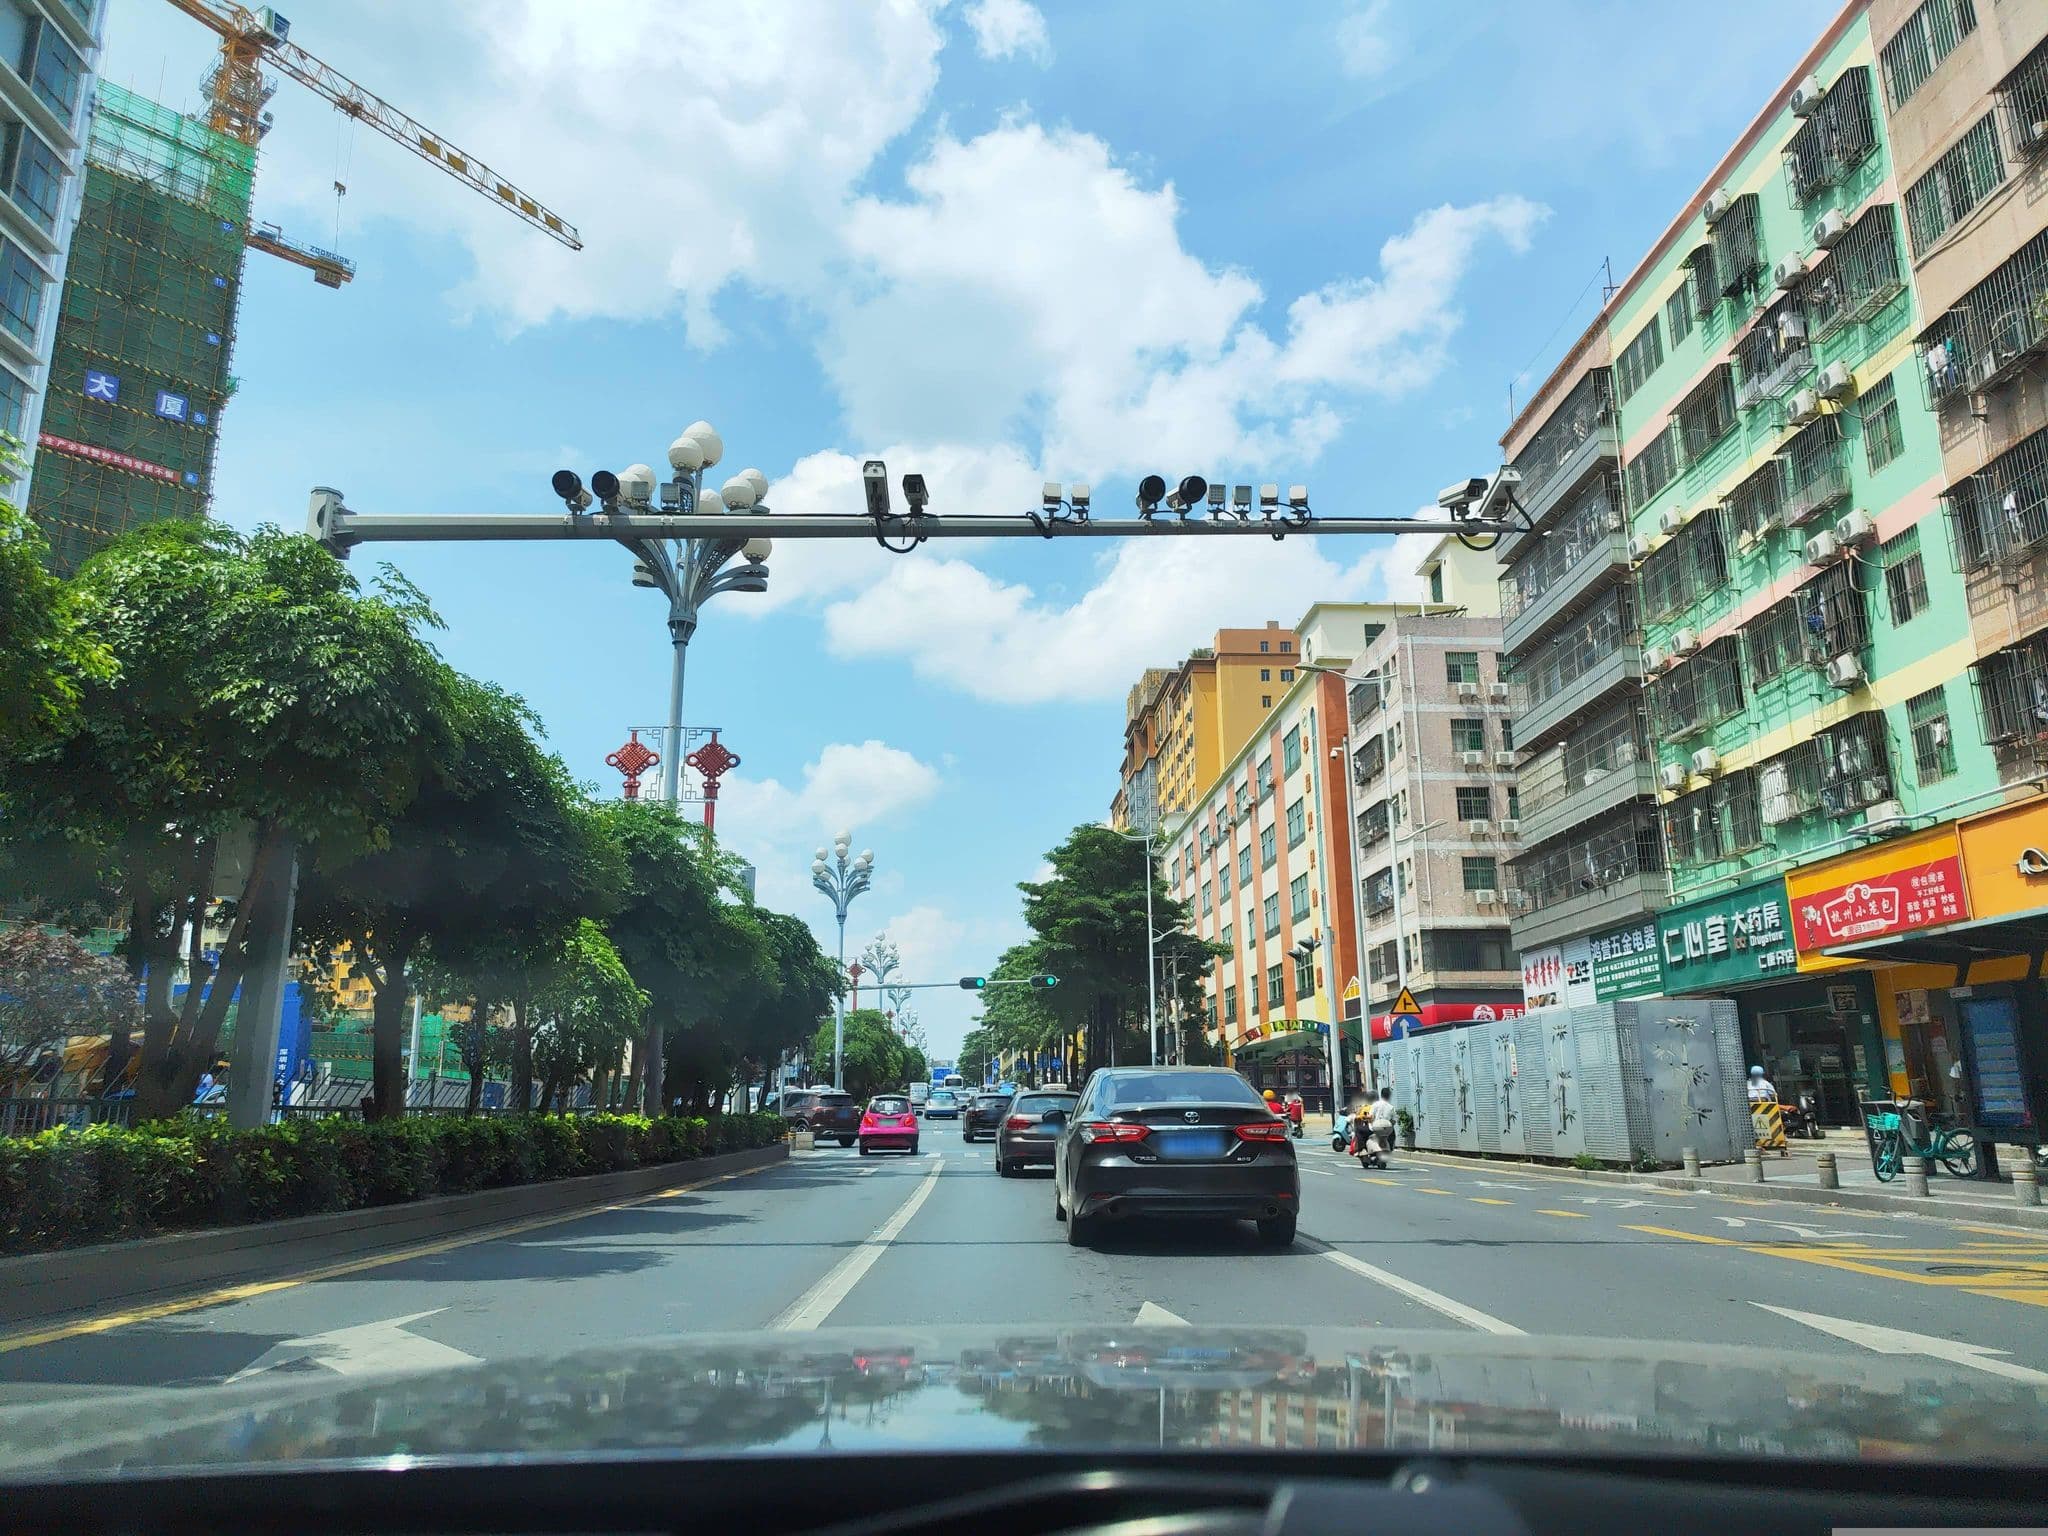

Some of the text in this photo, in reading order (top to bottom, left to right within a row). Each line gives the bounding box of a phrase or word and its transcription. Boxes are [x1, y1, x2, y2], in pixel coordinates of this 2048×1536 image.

[1831, 897, 1894, 923] 杭州小笼包
[1591, 924, 1656, 963] 鸿誉五金电器
